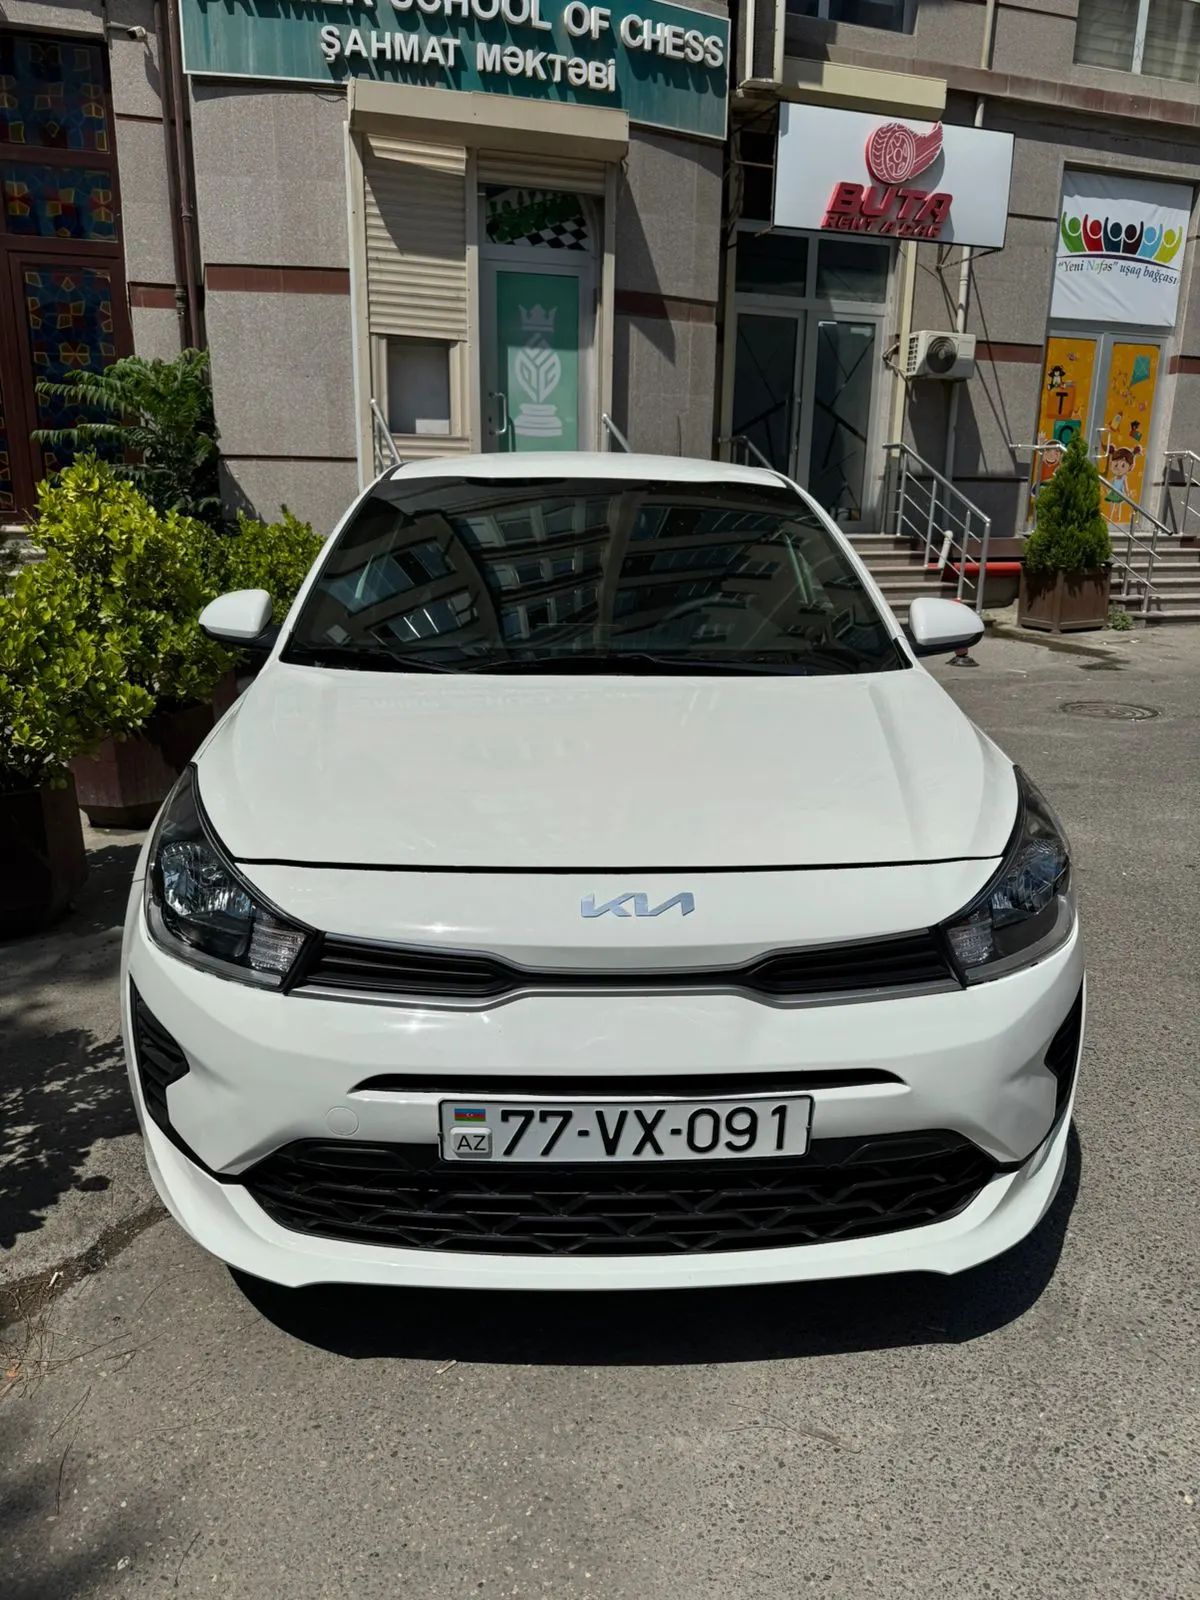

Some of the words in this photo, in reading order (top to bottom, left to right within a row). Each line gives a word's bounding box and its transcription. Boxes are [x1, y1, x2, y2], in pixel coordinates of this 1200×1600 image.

[563, 1, 611, 40] OF
[620, 14, 724, 68] CHESS
[320, 25, 460, 67] ŞAHMAT
[476, 42, 616, 93] MƏKTƏBİ
[826, 181, 953, 224] BUTA
[820, 213, 877, 232] RENT
[1119, 264, 1142, 279] uşaq
[1143, 266, 1178, 285] bağçası
[1056, 392, 1068, 415] T
[456, 1134, 487, 1151] AZ
[500, 1105, 788, 1157] 77-VX-091
